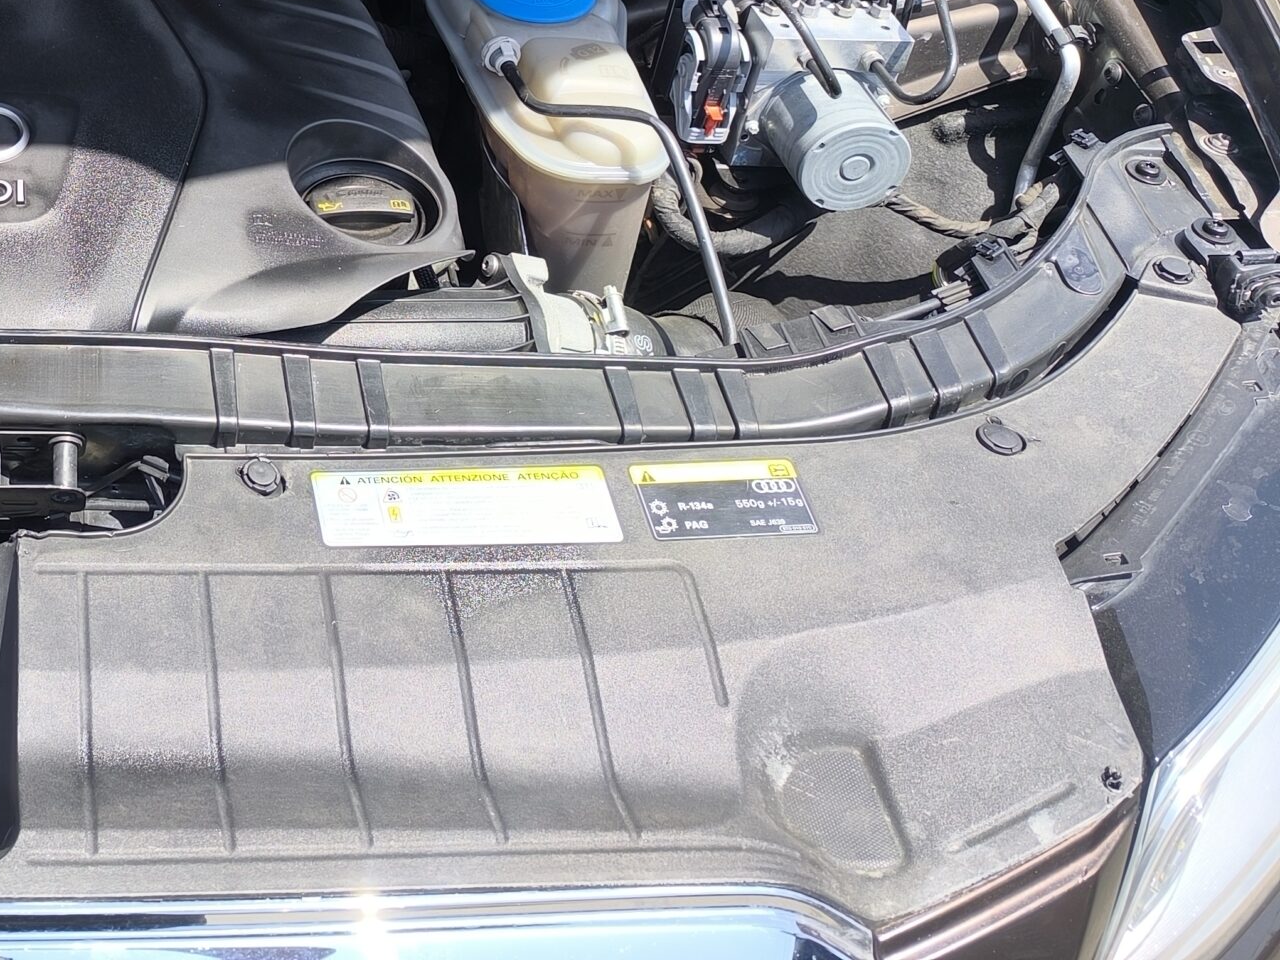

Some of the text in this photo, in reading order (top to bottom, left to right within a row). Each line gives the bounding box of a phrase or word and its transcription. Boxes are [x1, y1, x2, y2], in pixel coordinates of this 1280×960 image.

[577, 189, 614, 198] MAX
[357, 470, 580, 485] ATENCIÓN ATTENZIONE ATENÇÃO
[677, 501, 715, 512] R-134a
[734, 499, 765, 510] 550g
[684, 520, 709, 530] PAG
[749, 519, 767, 527] SAE
